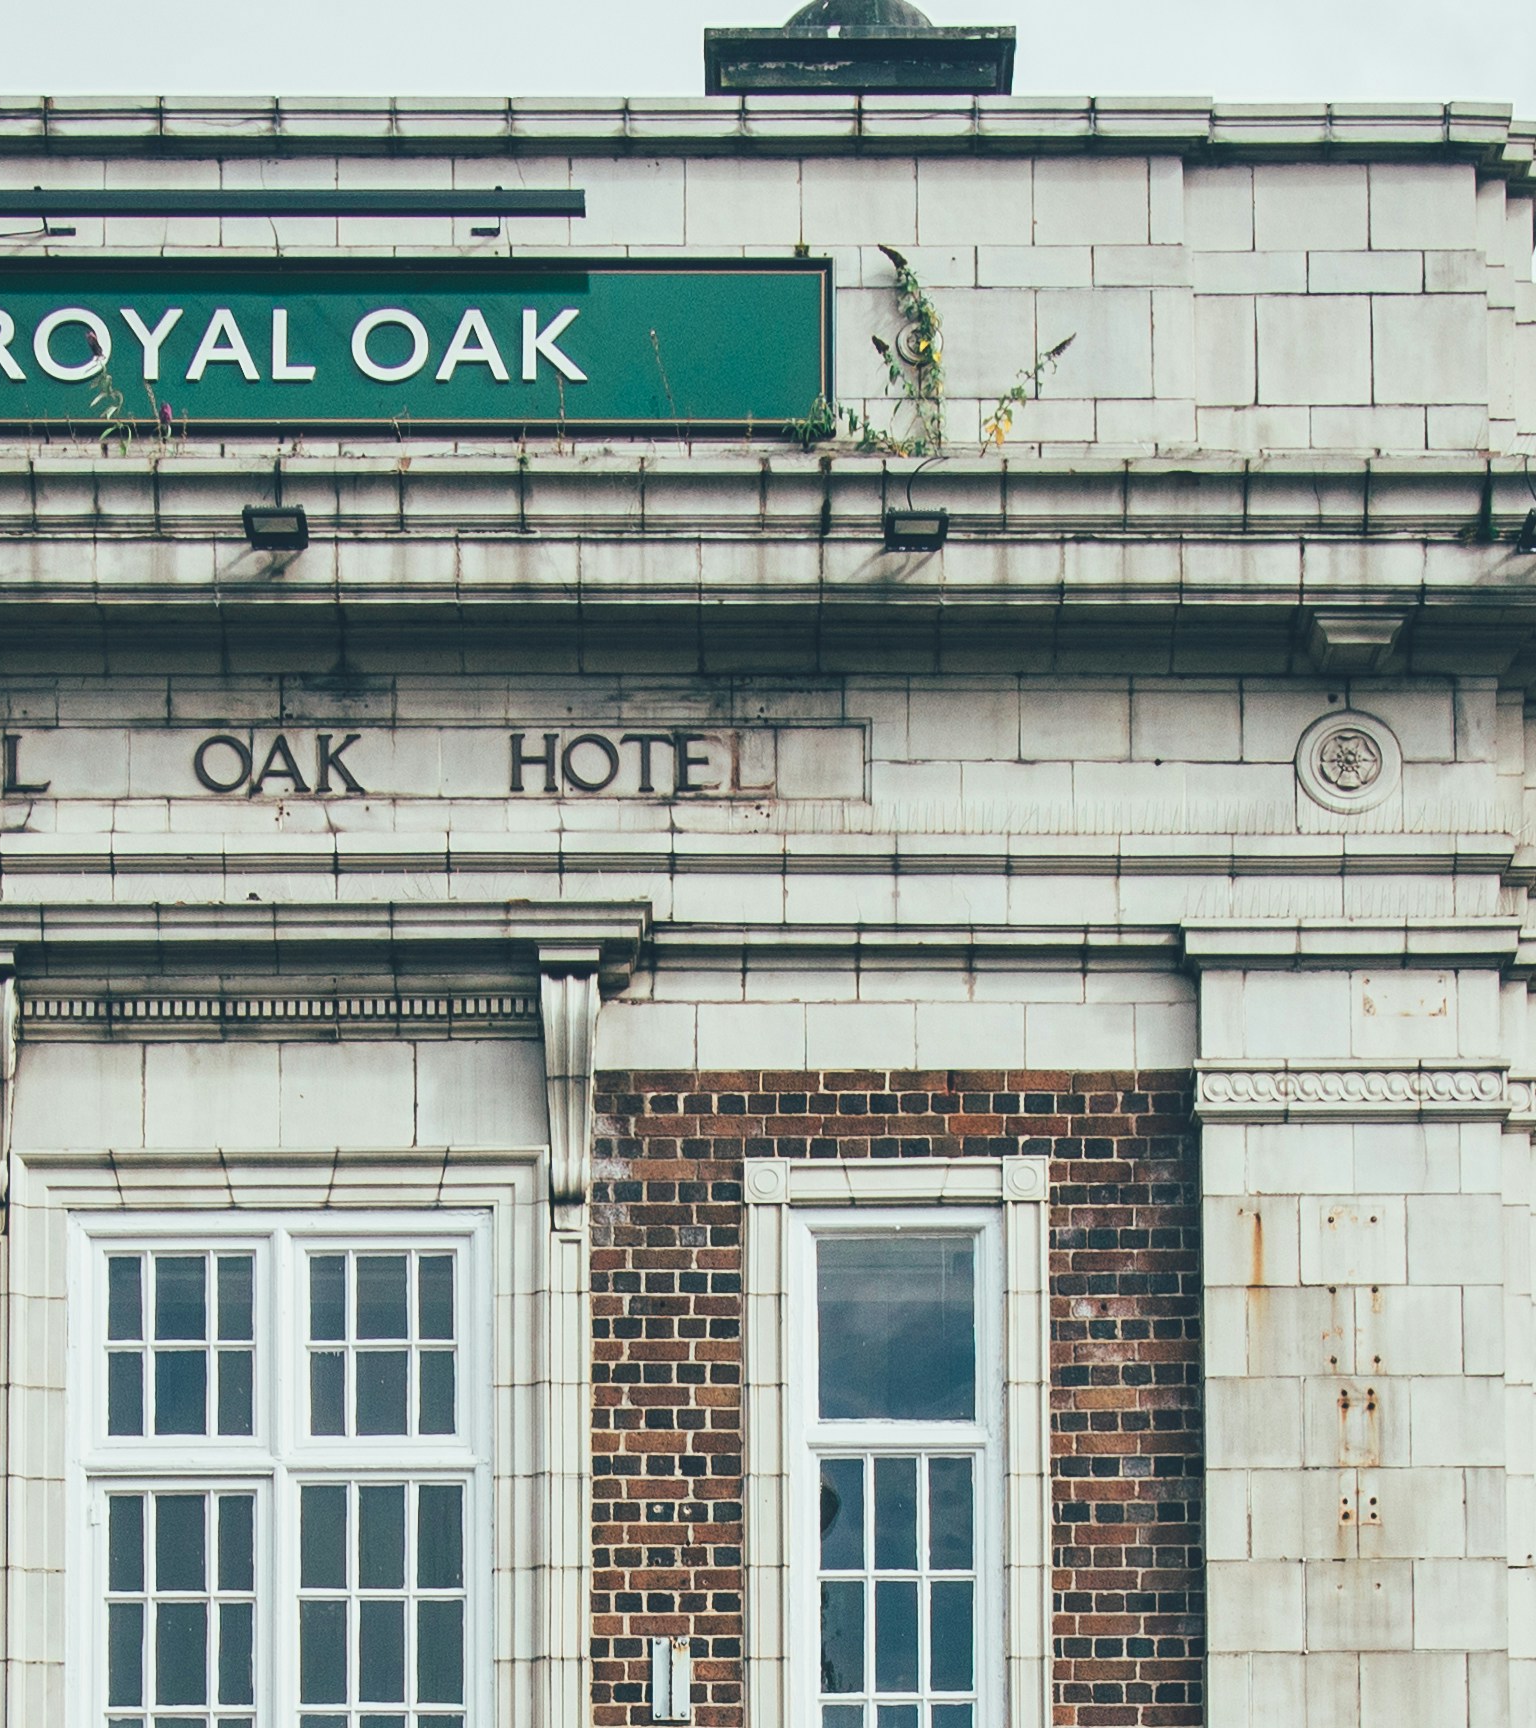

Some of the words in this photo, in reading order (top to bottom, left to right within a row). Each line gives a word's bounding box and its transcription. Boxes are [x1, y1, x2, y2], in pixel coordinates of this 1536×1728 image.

[351, 307, 589, 382] OAK
[192, 732, 367, 796] OAK
[510, 732, 778, 794] HOTEL
